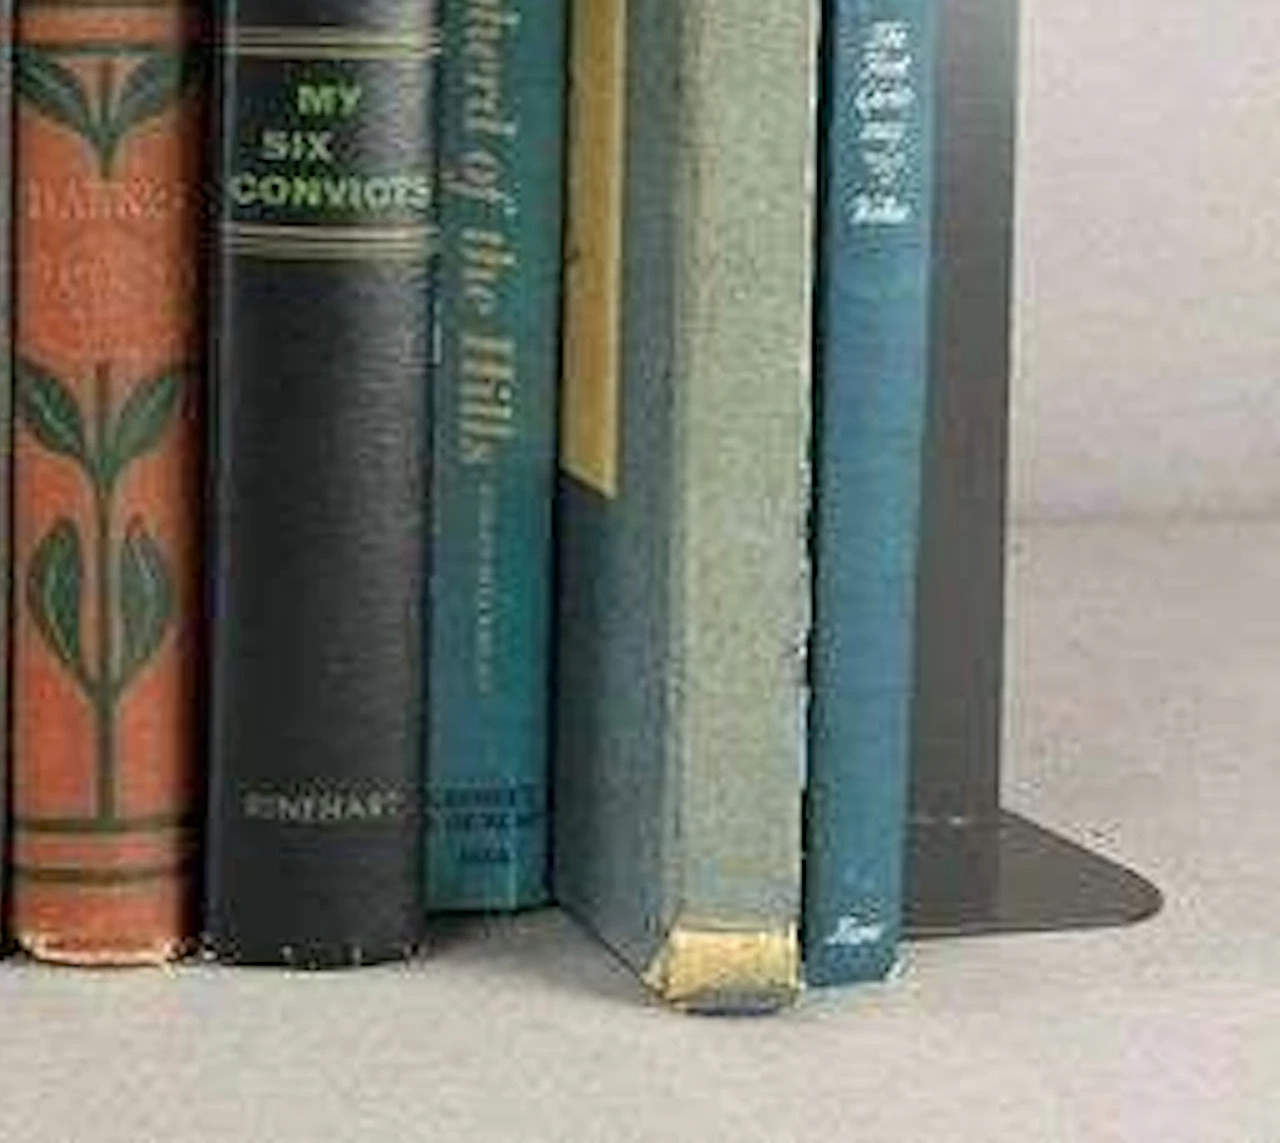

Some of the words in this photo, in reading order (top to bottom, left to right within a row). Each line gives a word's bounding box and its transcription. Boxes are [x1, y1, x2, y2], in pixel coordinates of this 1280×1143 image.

[296, 83, 363, 116] MY
[261, 130, 338, 161] SIX
[229, 176, 432, 209] CONVICTS
[439, 146, 518, 218] of
[462, 228, 515, 316] the
[458, 334, 516, 464] Hills
